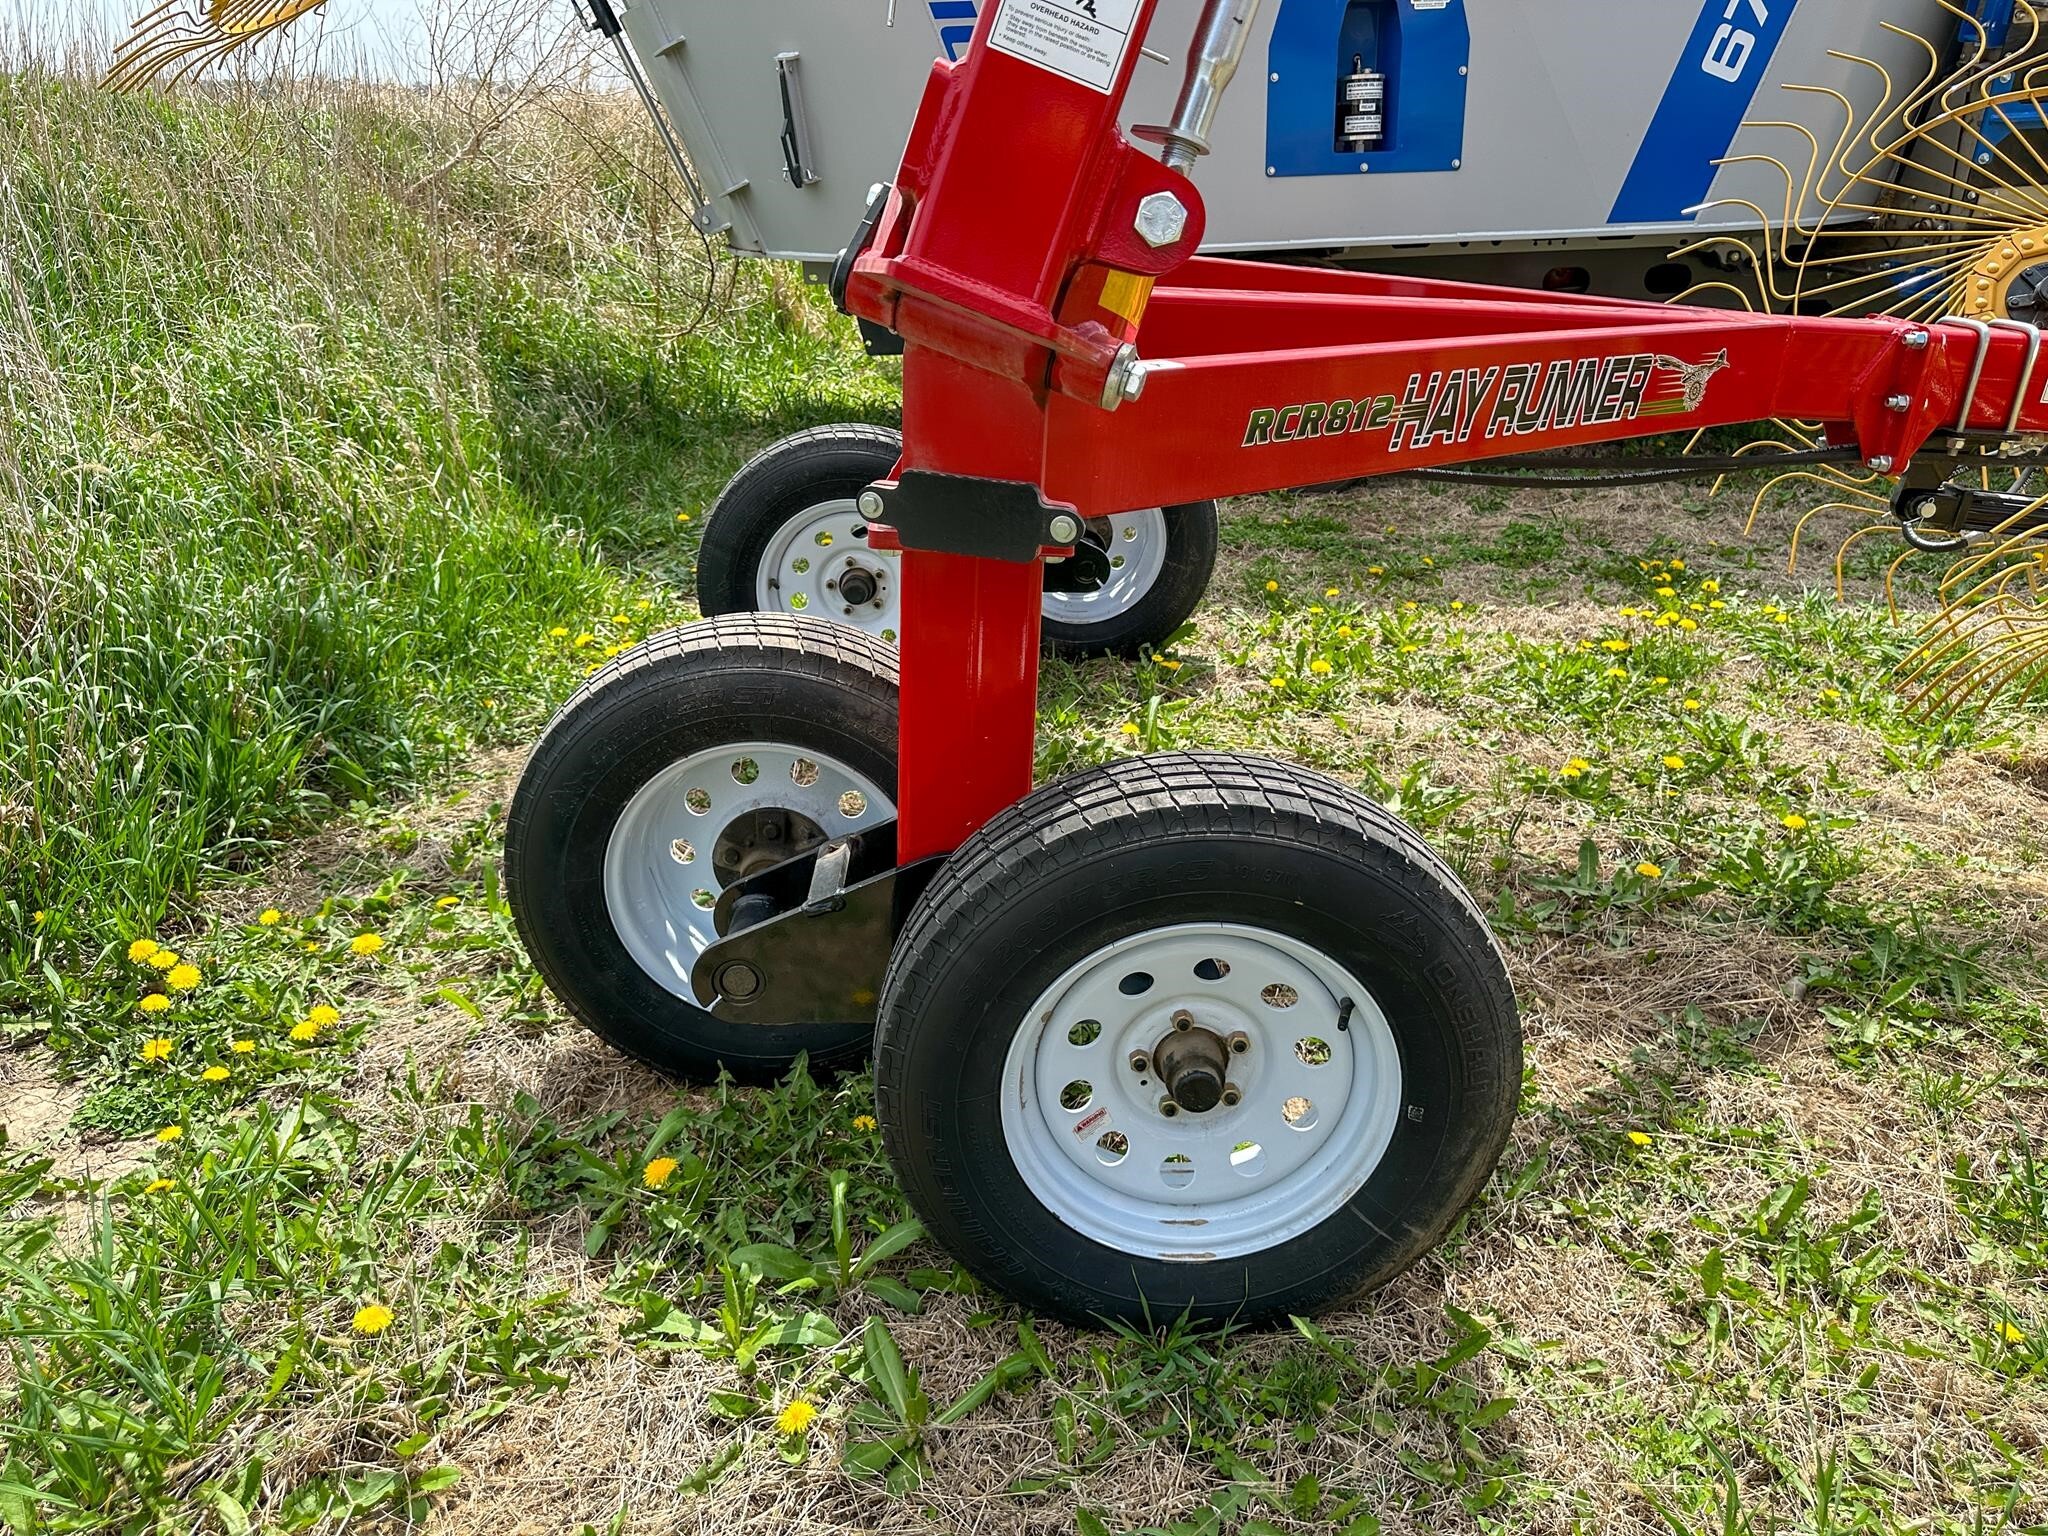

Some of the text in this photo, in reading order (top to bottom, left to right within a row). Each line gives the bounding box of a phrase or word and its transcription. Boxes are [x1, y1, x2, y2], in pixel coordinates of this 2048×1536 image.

[1010, 14, 1021, 24] Stay
[1021, 20, 1035, 30] away
[1036, 25, 1048, 34] from
[1048, 30, 1069, 43] beneath
[1078, 43, 1093, 53] wings
[1094, 50, 1108, 58] when
[1015, 9, 1035, 20] prevent
[1034, 16, 1053, 28] serious
[1053, 24, 1068, 35] injury
[1030, 2, 1100, 35] OVERHEAD HAZARD
[1003, 34, 1016, 44] Keep
[1016, 40, 1033, 50] others
[1007, 20, 1018, 29] they
[1043, 35, 1060, 46] raised
[1059, 42, 1080, 55] position
[1096, 56, 1111, 67] being
[1240, 353, 1656, 453] RCR812 HAY RUNNER
